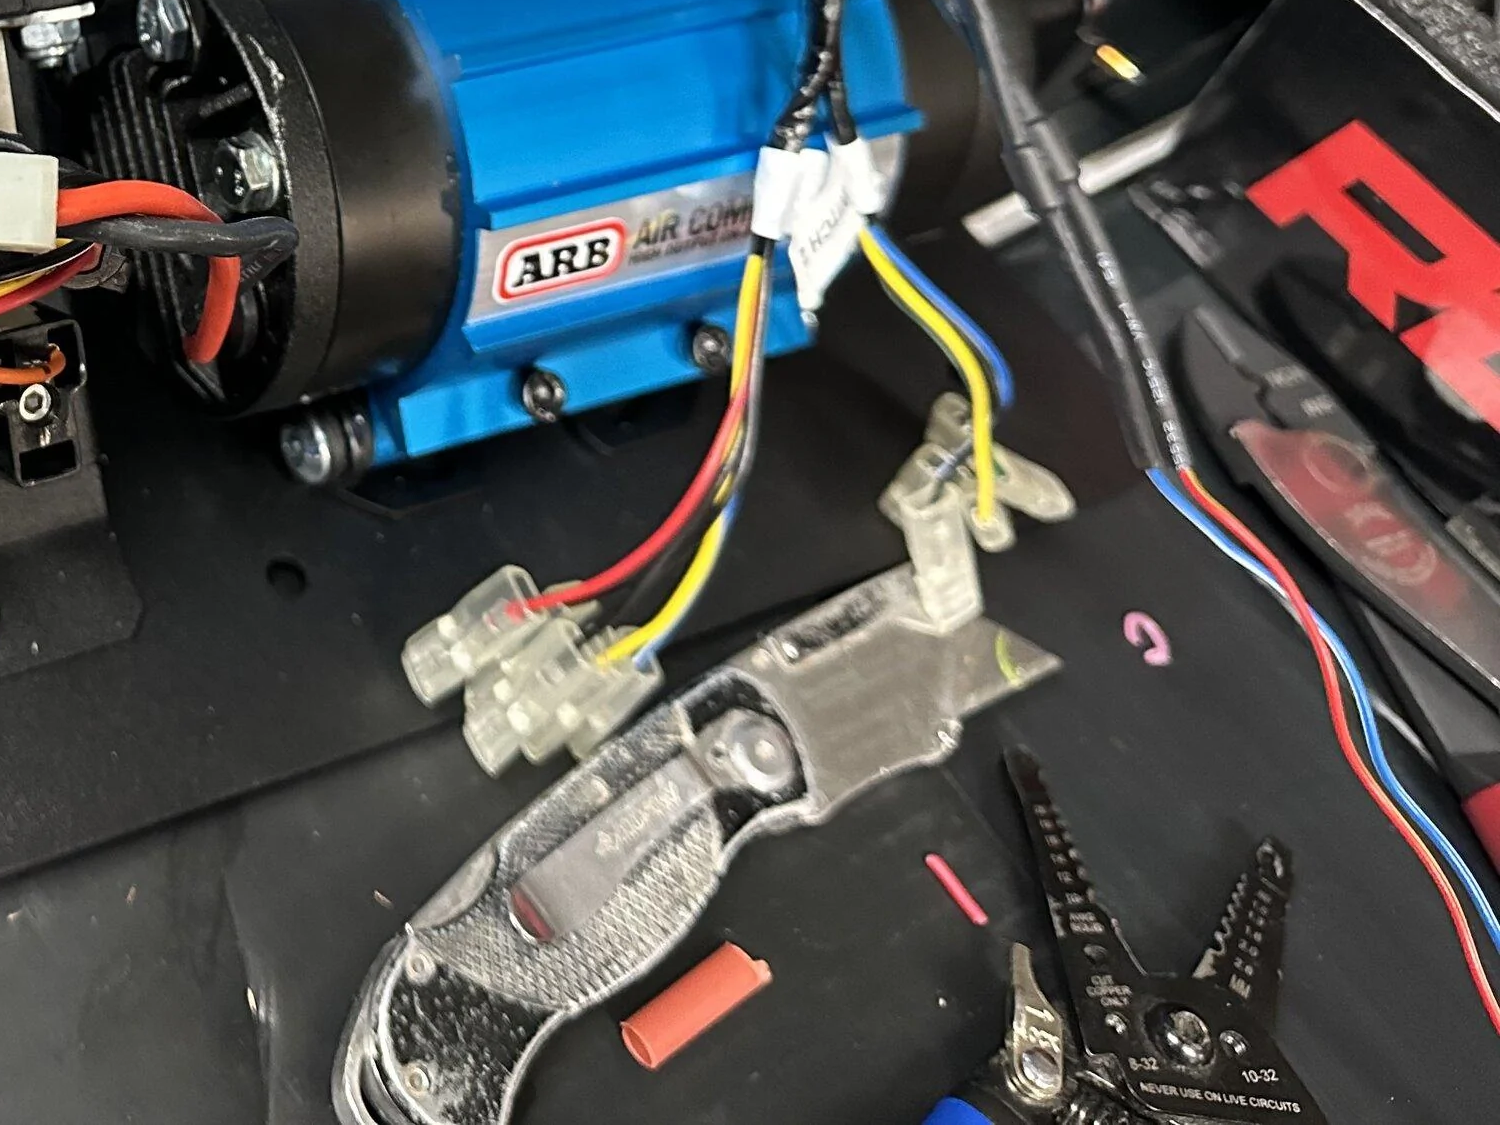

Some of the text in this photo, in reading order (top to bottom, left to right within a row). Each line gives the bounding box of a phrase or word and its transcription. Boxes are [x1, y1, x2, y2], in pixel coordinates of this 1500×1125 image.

[632, 207, 680, 249] AIR
[511, 237, 610, 287] ARB
[1085, 984, 1133, 998] COPPER
[1241, 1068, 1280, 1084] 10-32
[1139, 1081, 1302, 1114] NEVER USE ON LIVE CIRCUITS
